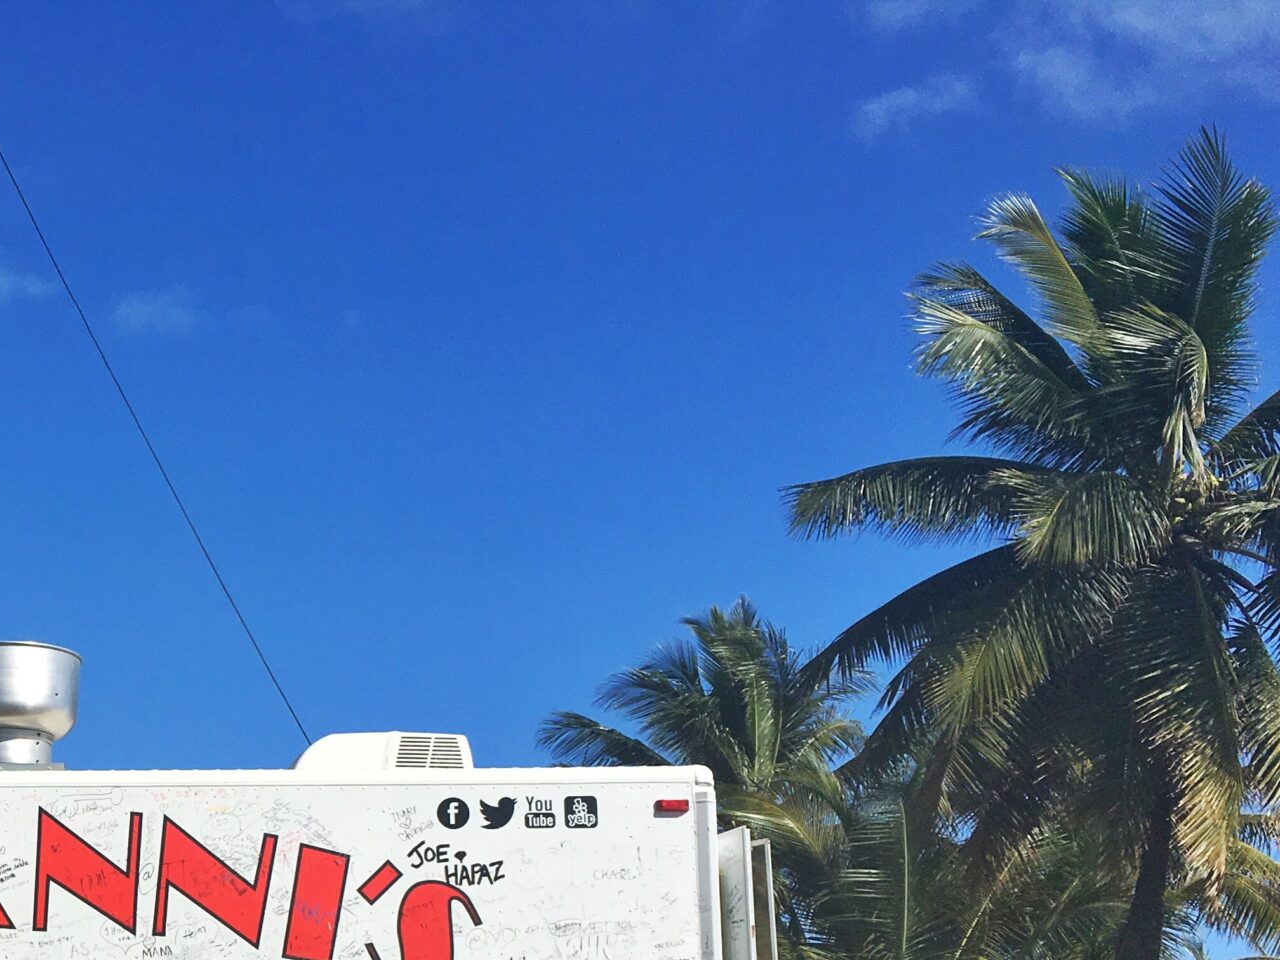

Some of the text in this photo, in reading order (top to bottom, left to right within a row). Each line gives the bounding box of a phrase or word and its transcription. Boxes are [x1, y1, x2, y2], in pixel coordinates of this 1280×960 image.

[525, 796, 553, 812] You
[527, 814, 555, 828] Tube
[567, 813, 596, 827] yelp
[407, 840, 450, 869] JOE
[444, 860, 506, 886] HAPAZ
